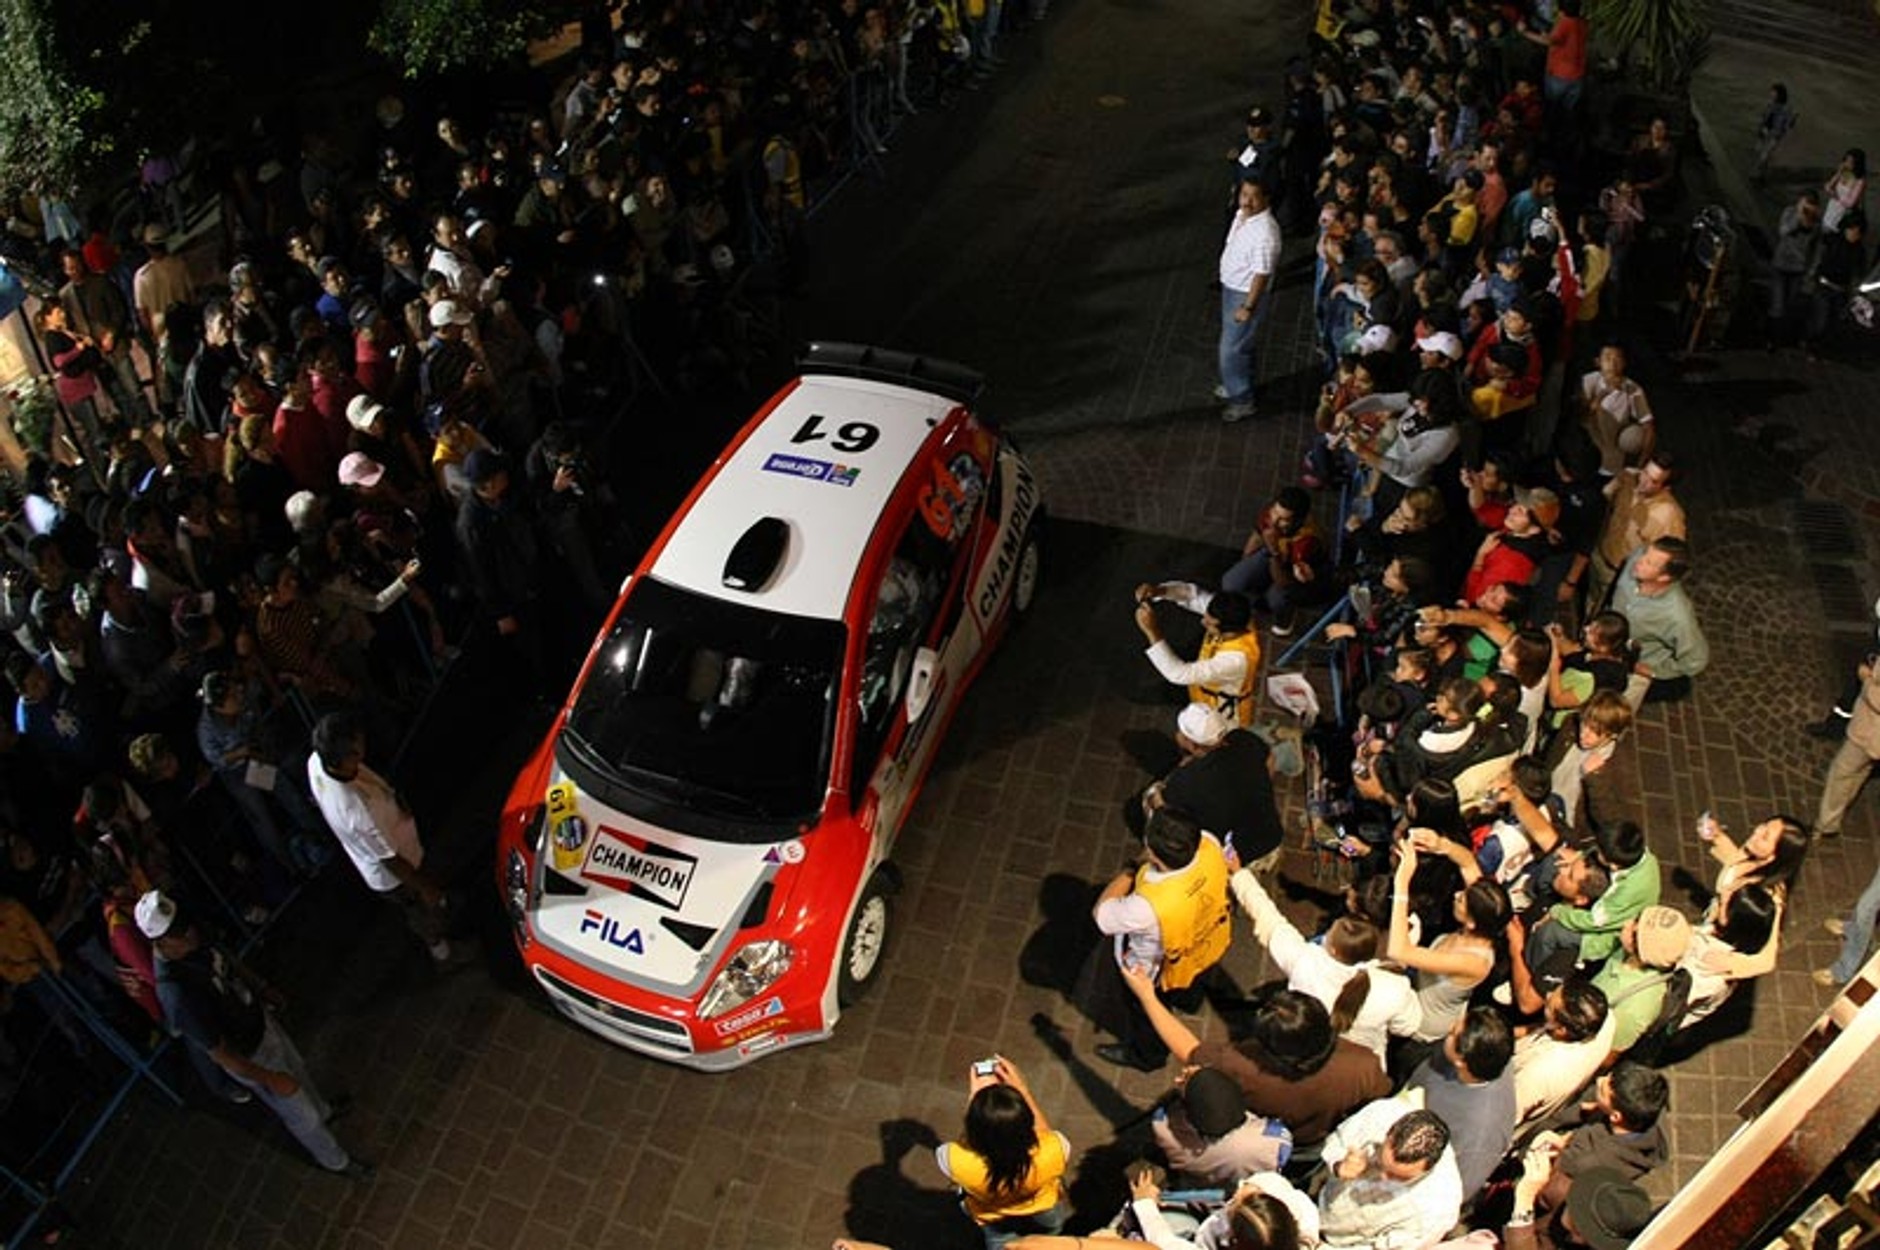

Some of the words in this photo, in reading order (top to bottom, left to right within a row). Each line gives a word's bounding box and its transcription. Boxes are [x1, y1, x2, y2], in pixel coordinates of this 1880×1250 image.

[790, 414, 880, 452] 61
[919, 457, 966, 537] 61
[980, 462, 1034, 618] CHAMPION
[550, 789, 565, 813] 61
[591, 843, 686, 892] CHAMPION
[580, 909, 645, 955] FILA
